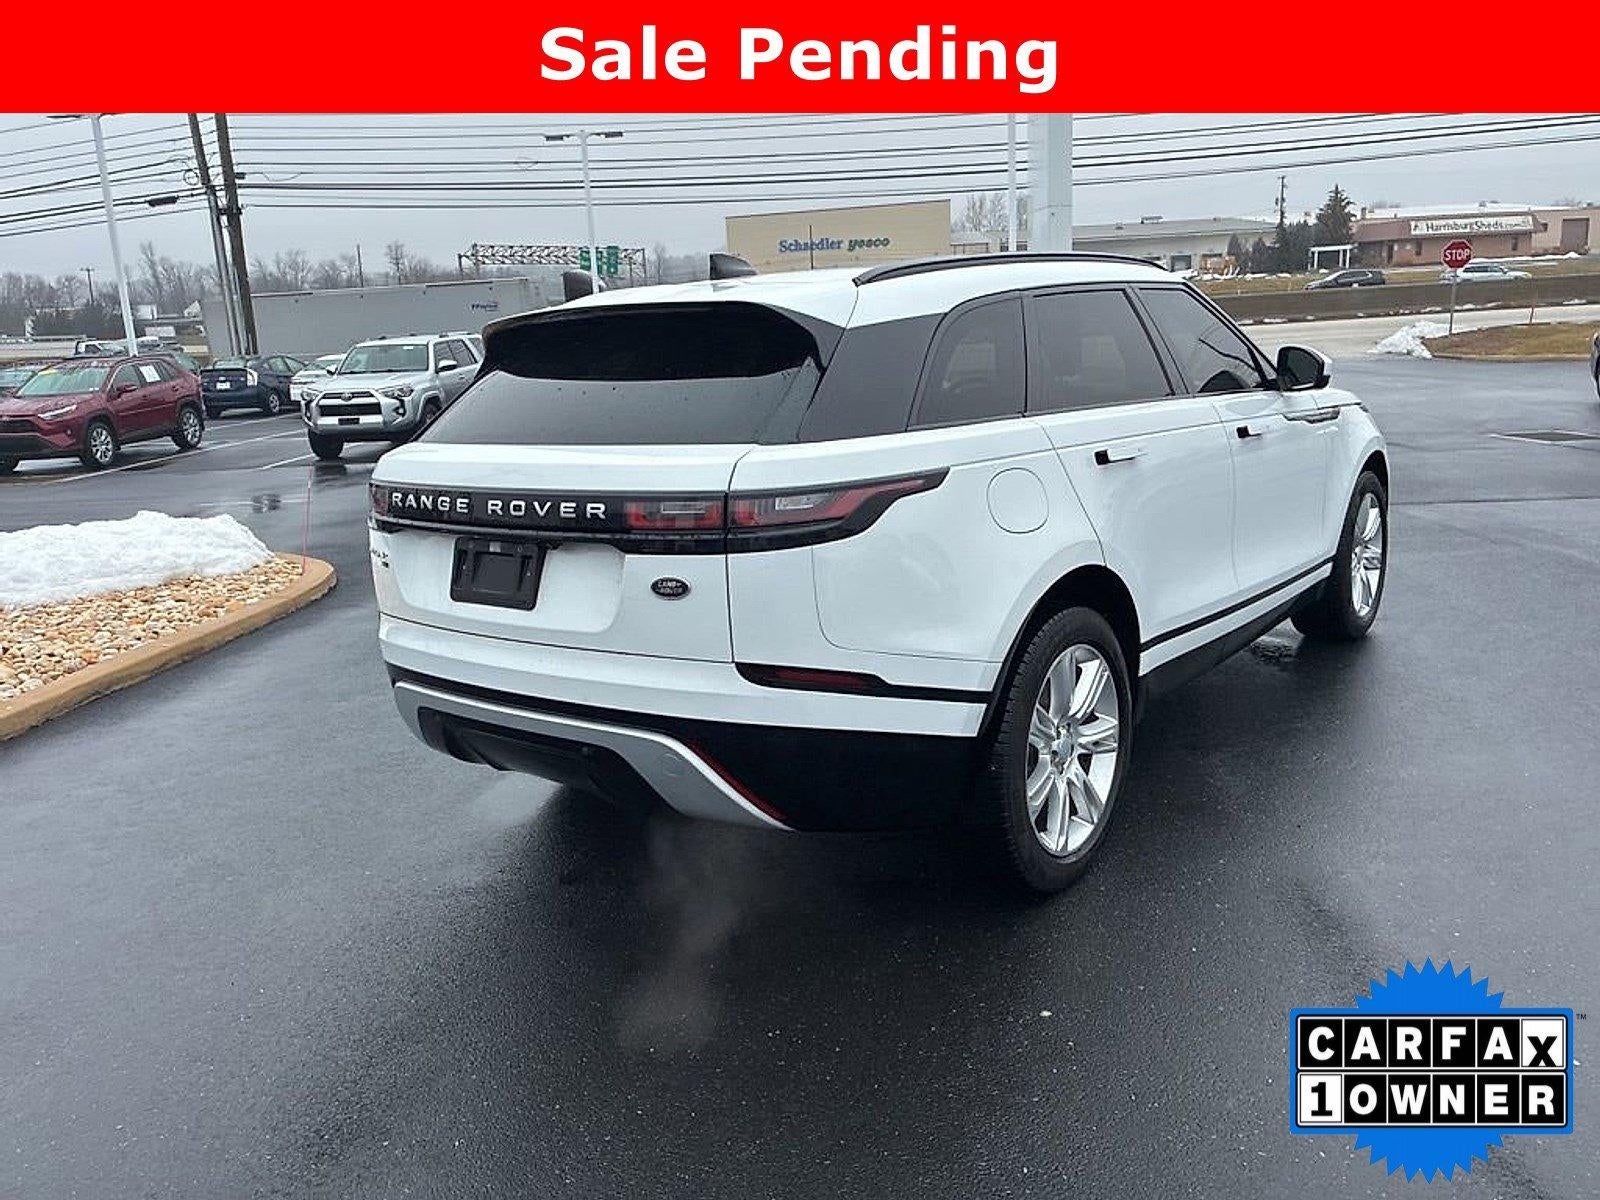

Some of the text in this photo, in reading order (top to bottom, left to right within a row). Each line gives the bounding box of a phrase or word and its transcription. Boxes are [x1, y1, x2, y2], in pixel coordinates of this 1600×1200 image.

[1445, 248, 1471, 261] STOP
[391, 492, 606, 519] RANGE ROVER
